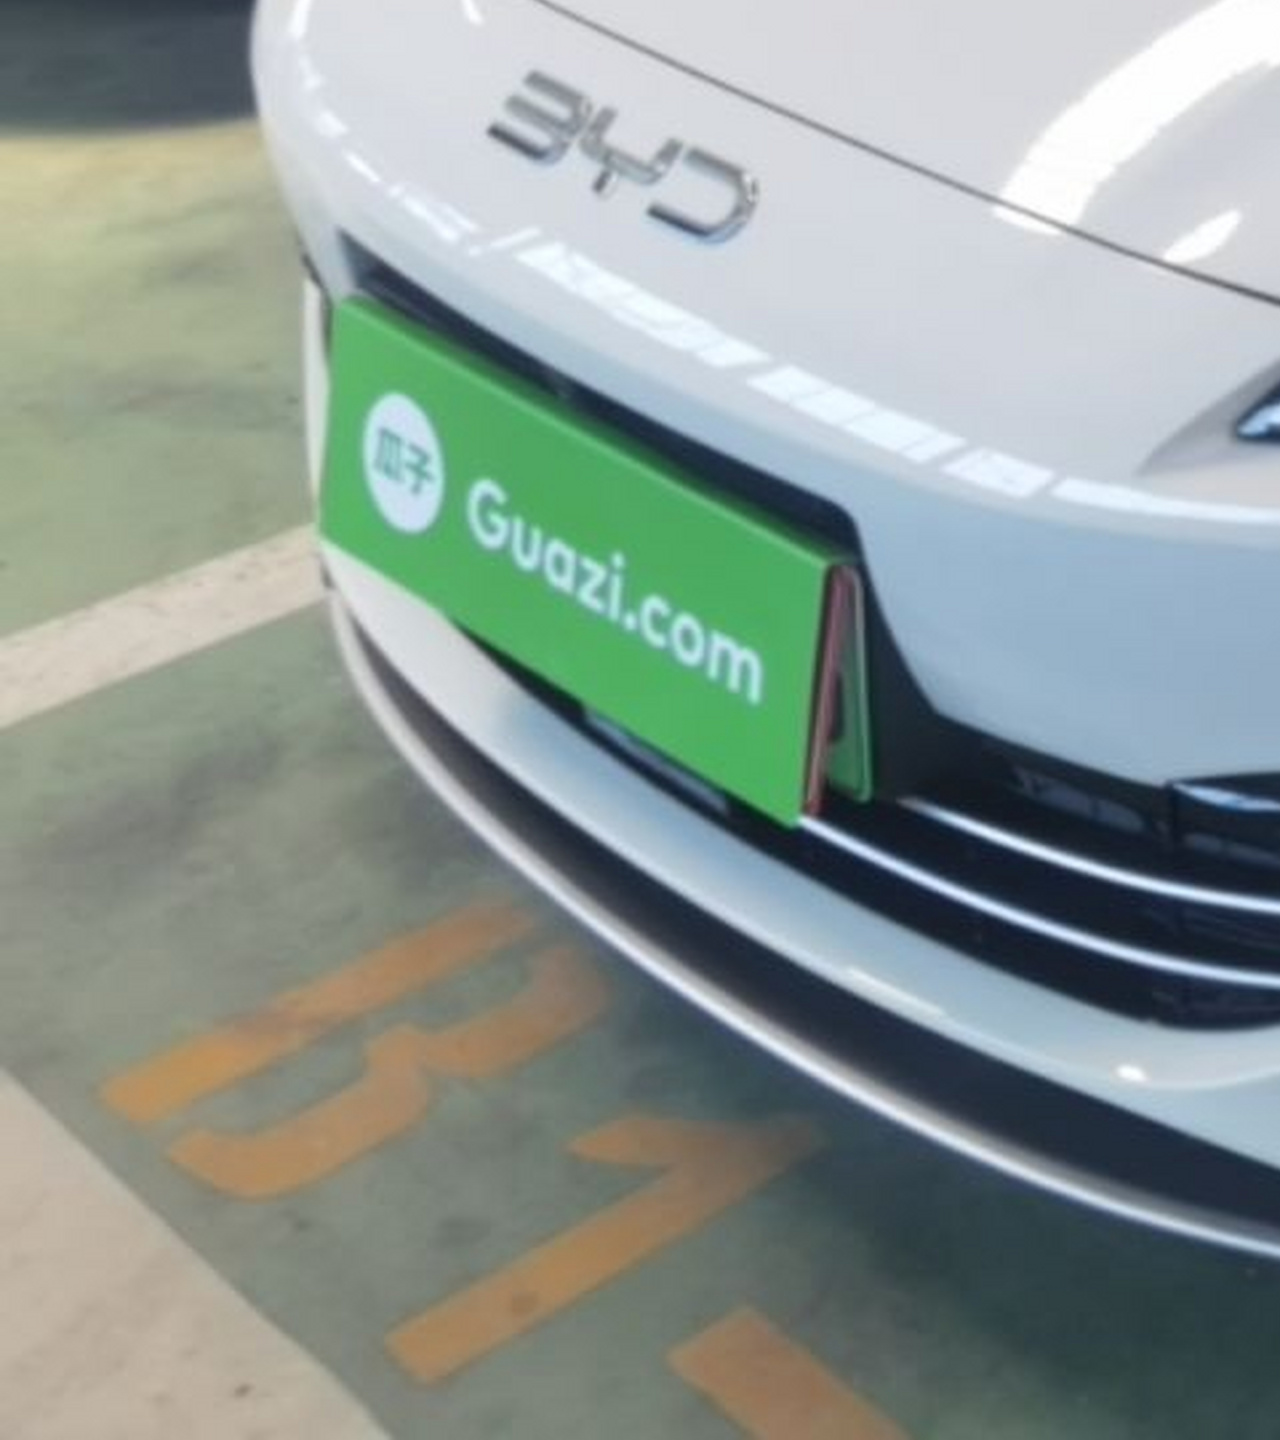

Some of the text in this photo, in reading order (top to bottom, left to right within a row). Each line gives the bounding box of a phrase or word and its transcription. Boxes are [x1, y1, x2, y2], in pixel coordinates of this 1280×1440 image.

[486, 70, 758, 244] BYD
[374, 427, 437, 496] 瓜子
[467, 478, 763, 705] Guazi.com
